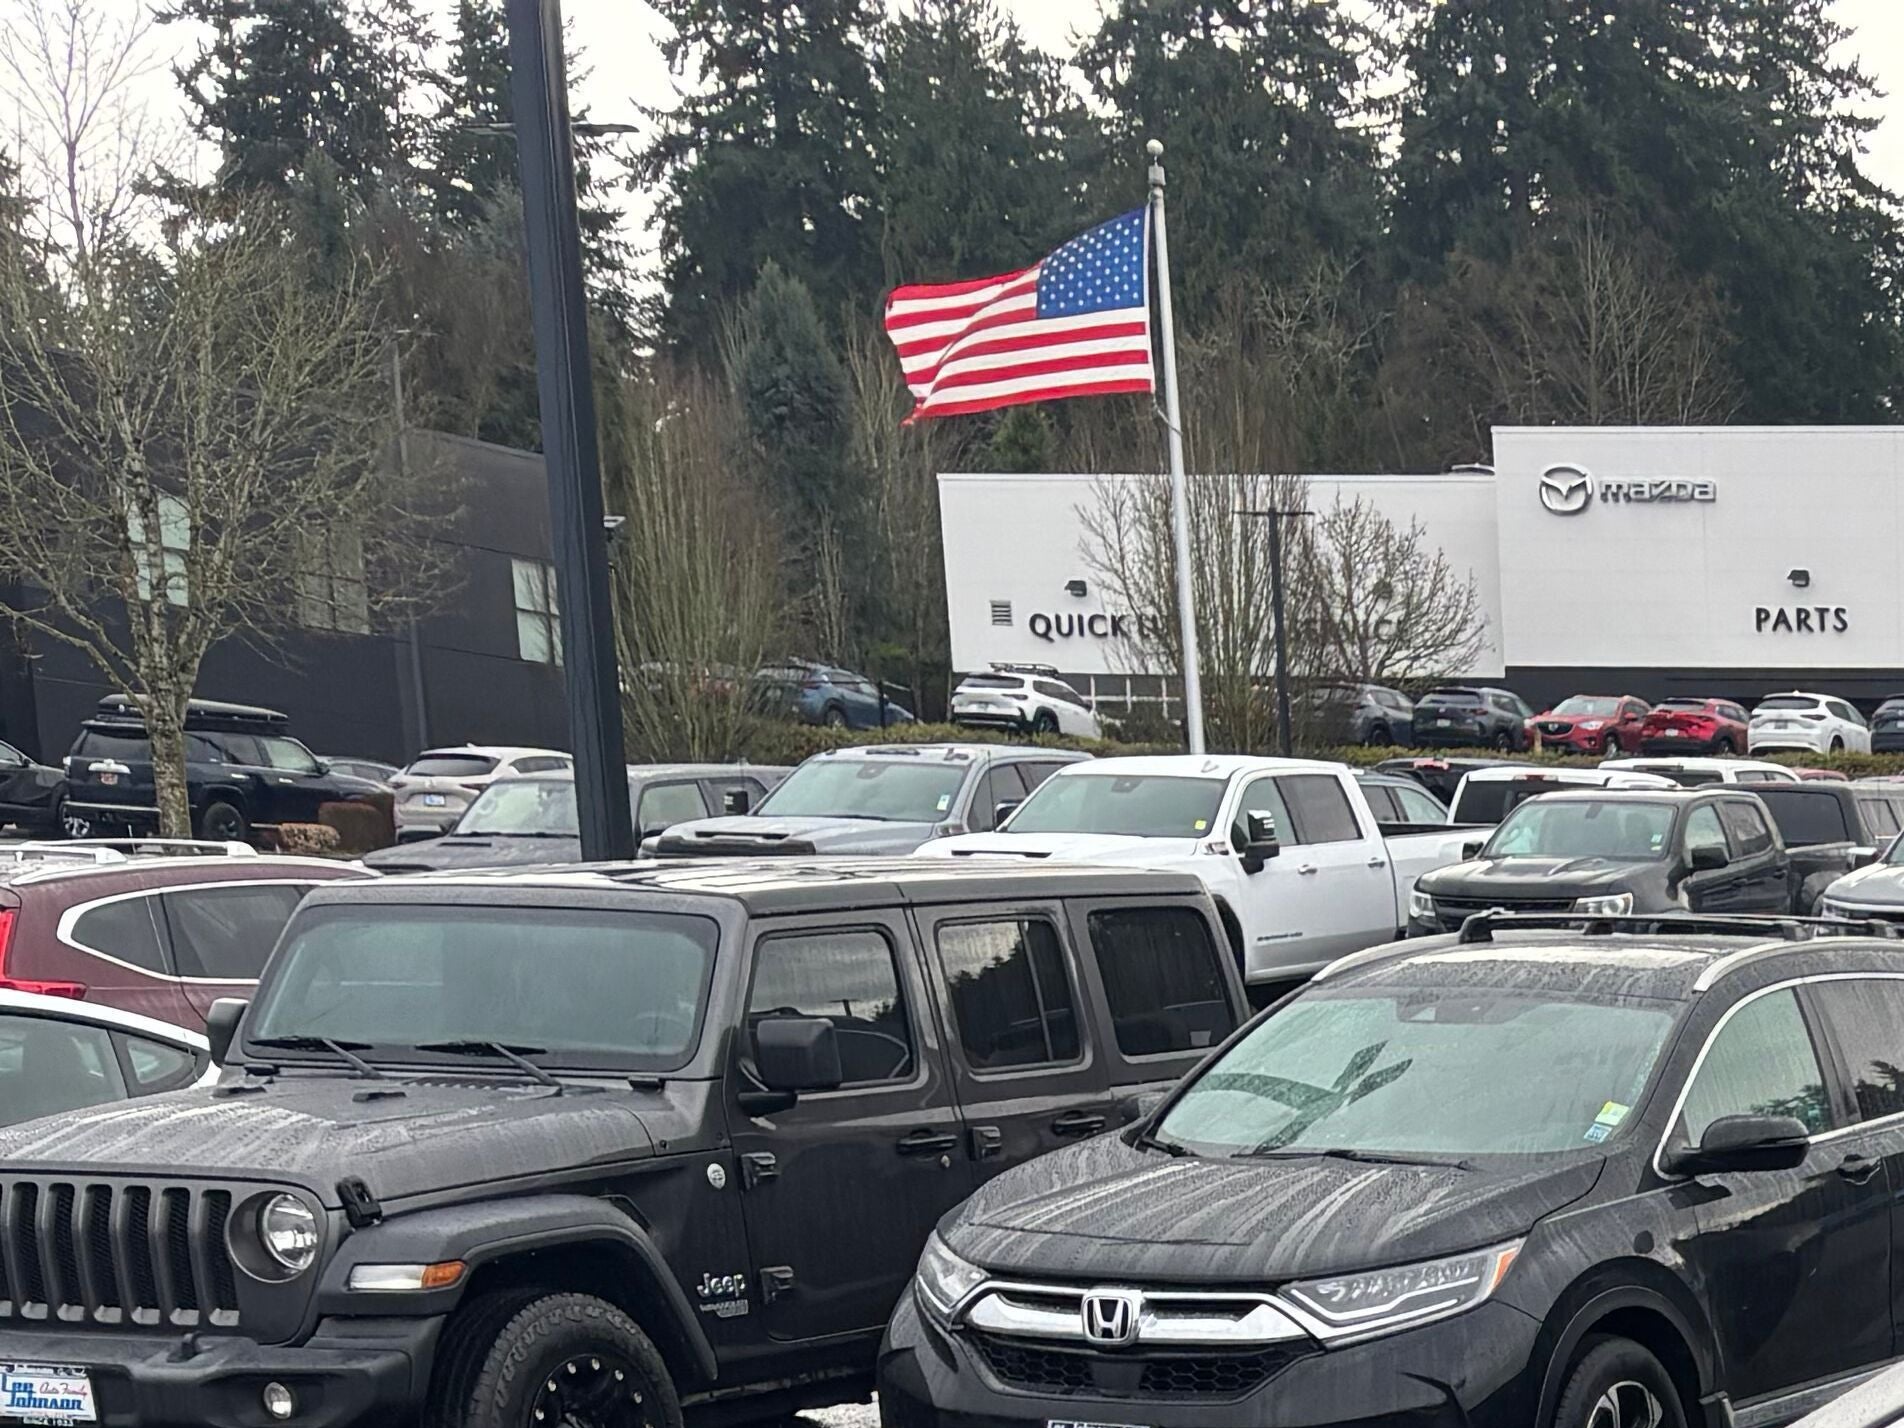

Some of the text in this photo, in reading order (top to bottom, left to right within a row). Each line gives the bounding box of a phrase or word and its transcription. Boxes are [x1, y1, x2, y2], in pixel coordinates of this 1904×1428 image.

[1029, 613, 1131, 642] QUICK
[1755, 607, 1849, 633] PARTS
[697, 1272, 746, 1297] Jeep
[2, 1372, 37, 1393] Lee
